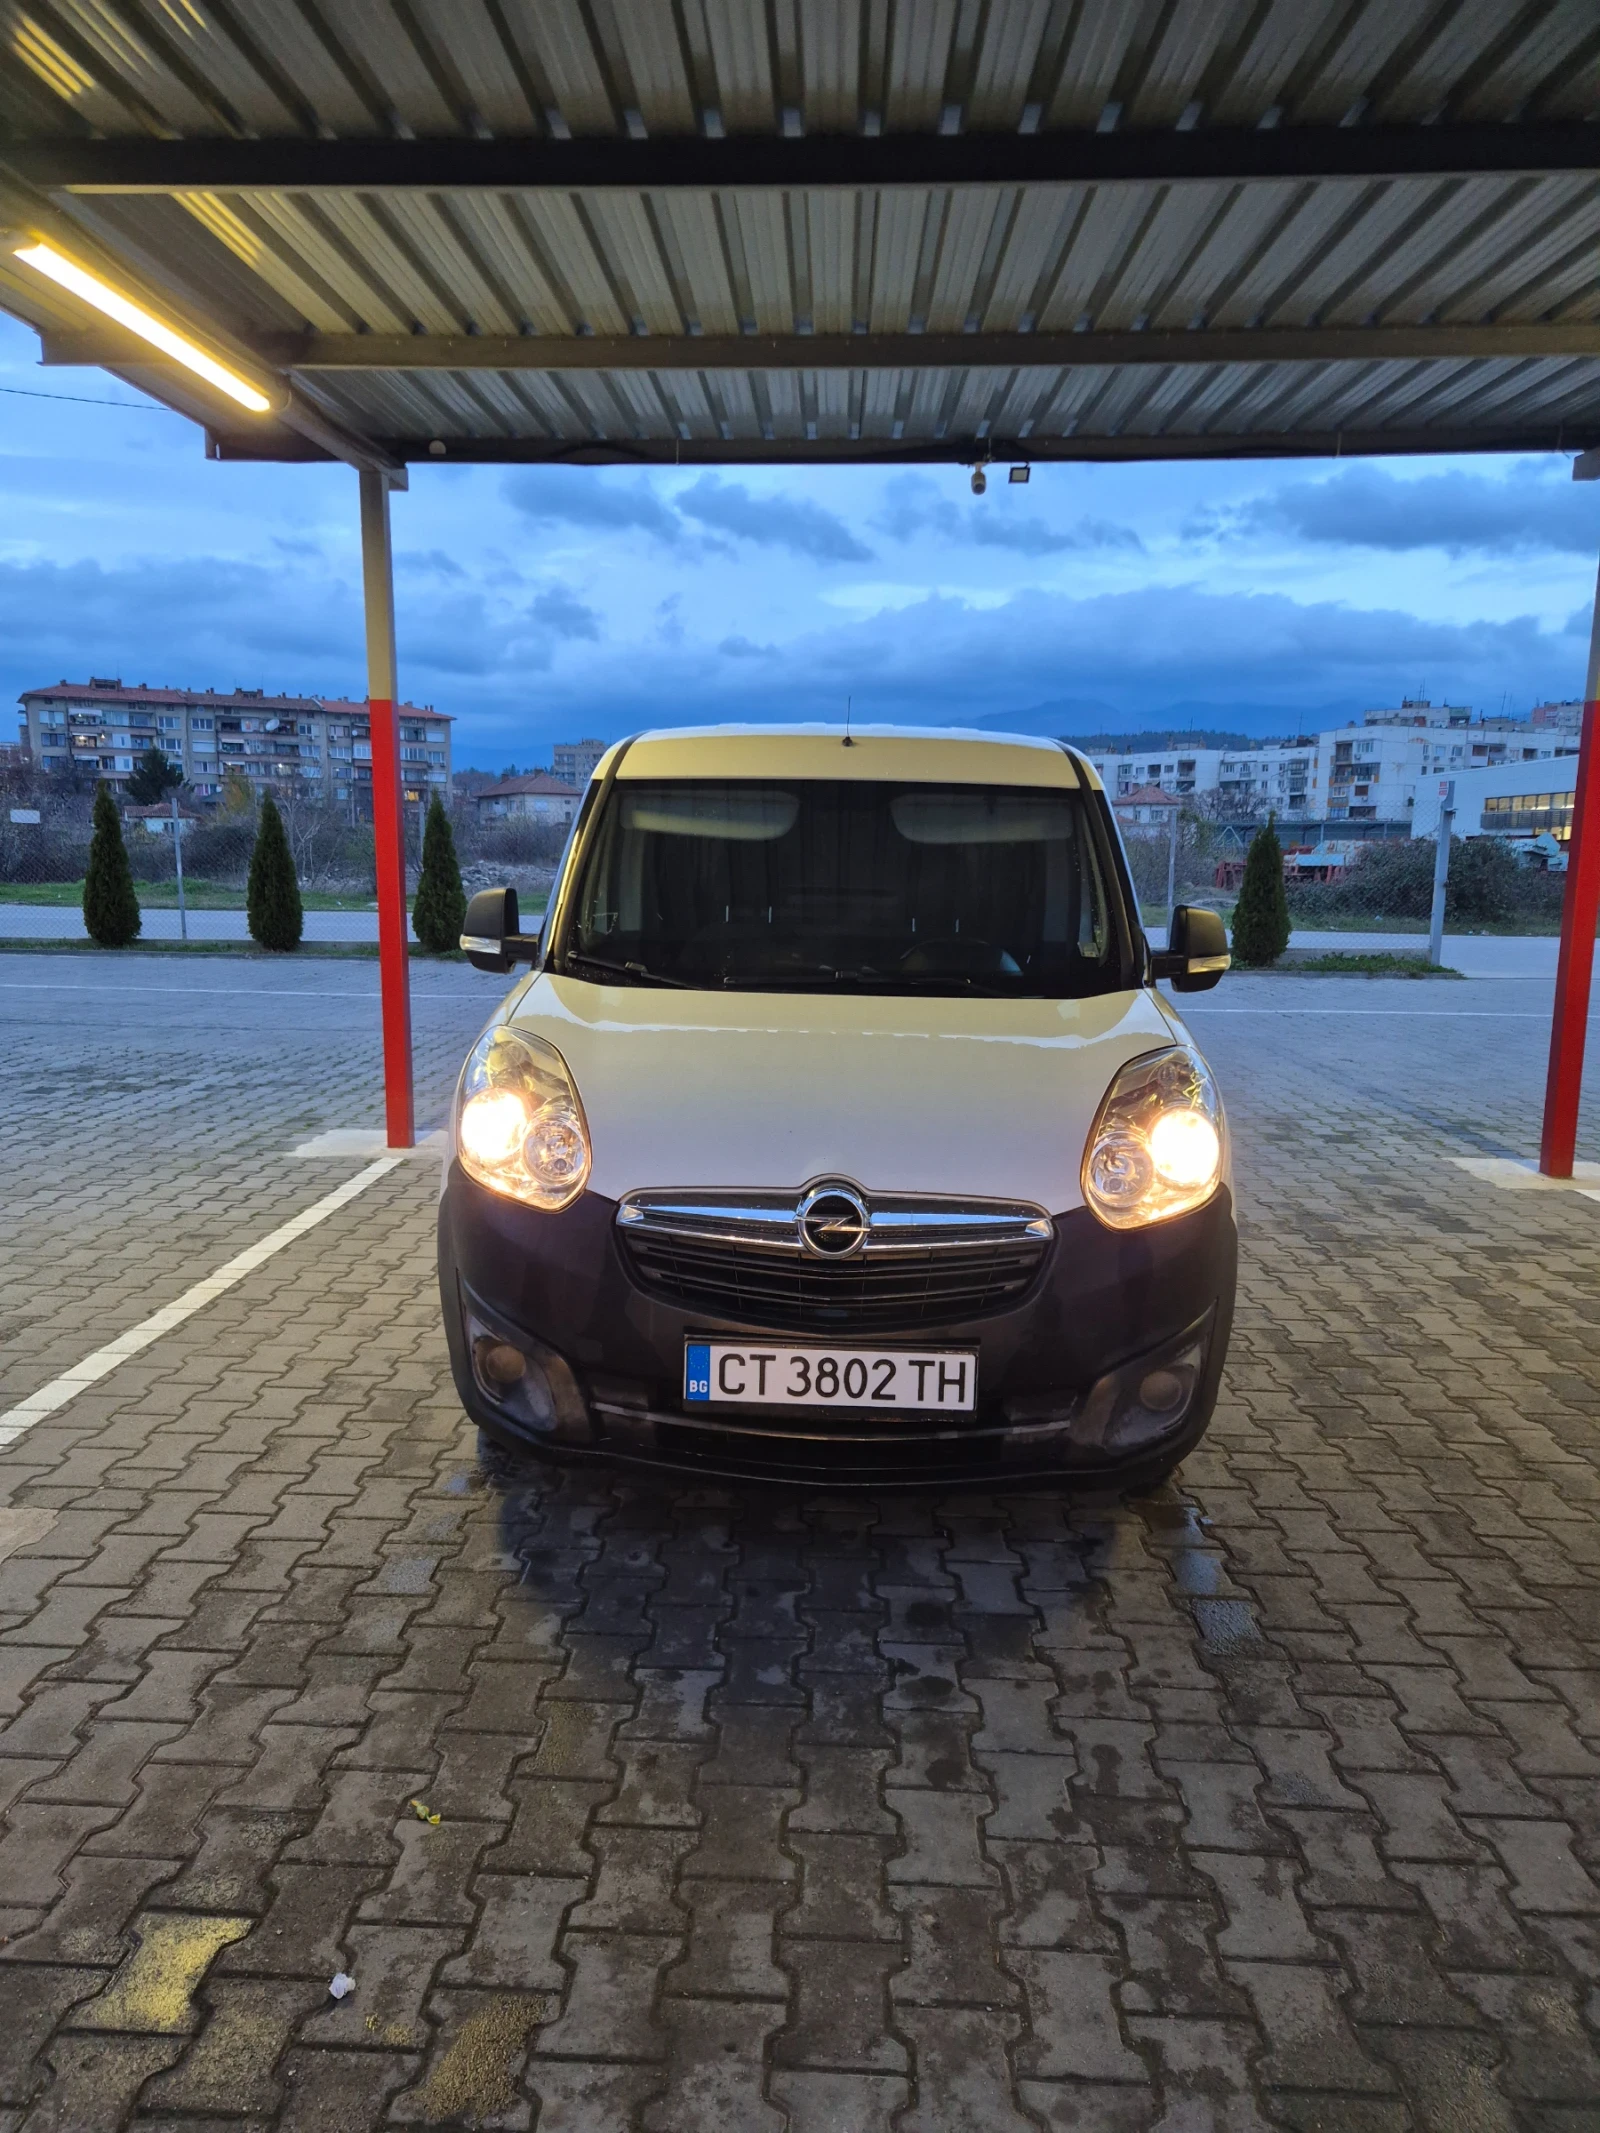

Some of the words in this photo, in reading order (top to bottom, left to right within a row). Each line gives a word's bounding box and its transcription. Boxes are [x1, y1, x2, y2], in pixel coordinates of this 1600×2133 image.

[689, 1380, 708, 1393] BG
[719, 1353, 777, 1396] CT
[787, 1356, 897, 1401] 3802
[908, 1360, 966, 1403] TH
